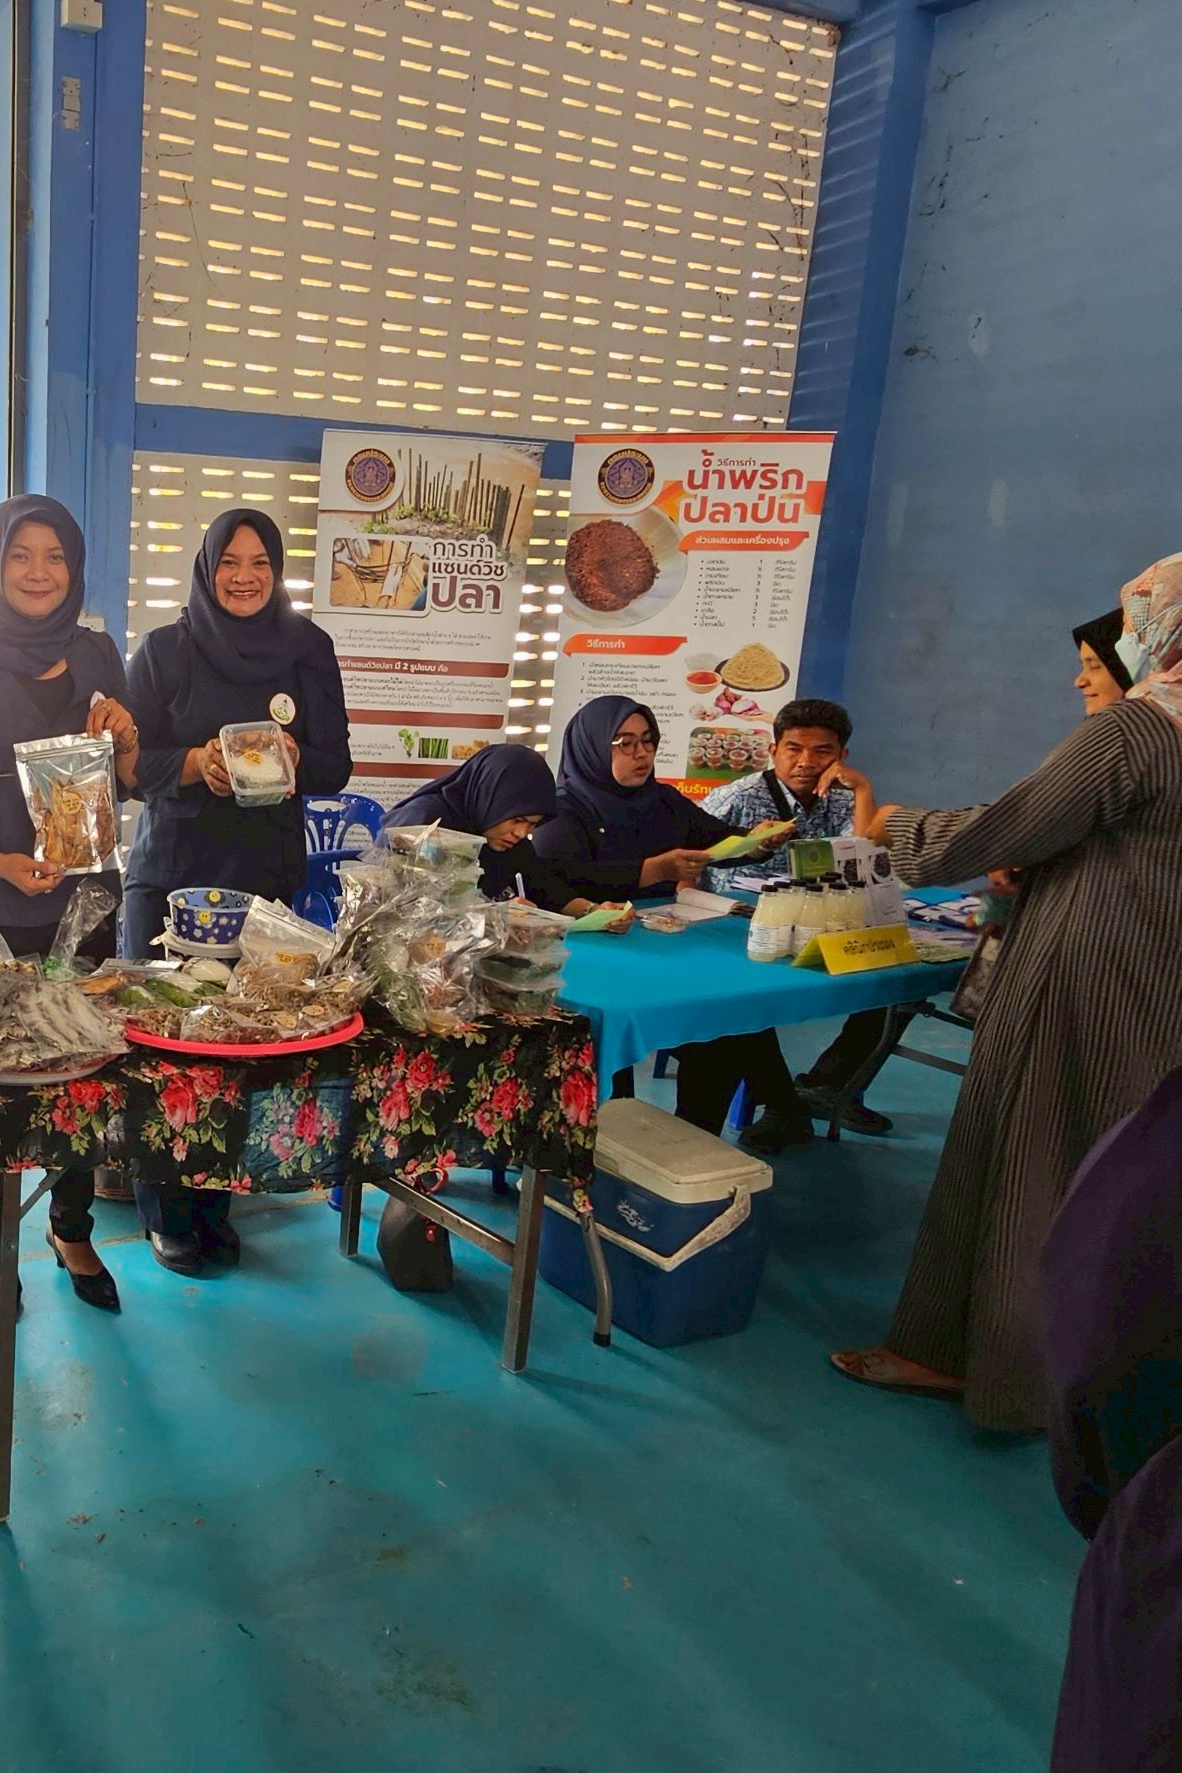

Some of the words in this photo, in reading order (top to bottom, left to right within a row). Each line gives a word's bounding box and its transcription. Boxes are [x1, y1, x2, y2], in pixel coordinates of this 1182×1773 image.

[687, 449, 804, 490] น้ำพริก
[433, 537, 493, 559] การทำ
[432, 559, 505, 577] แซนด์วิช
[431, 576, 501, 610] ปลา
[410, 664, 436, 673] รูปแบบ
